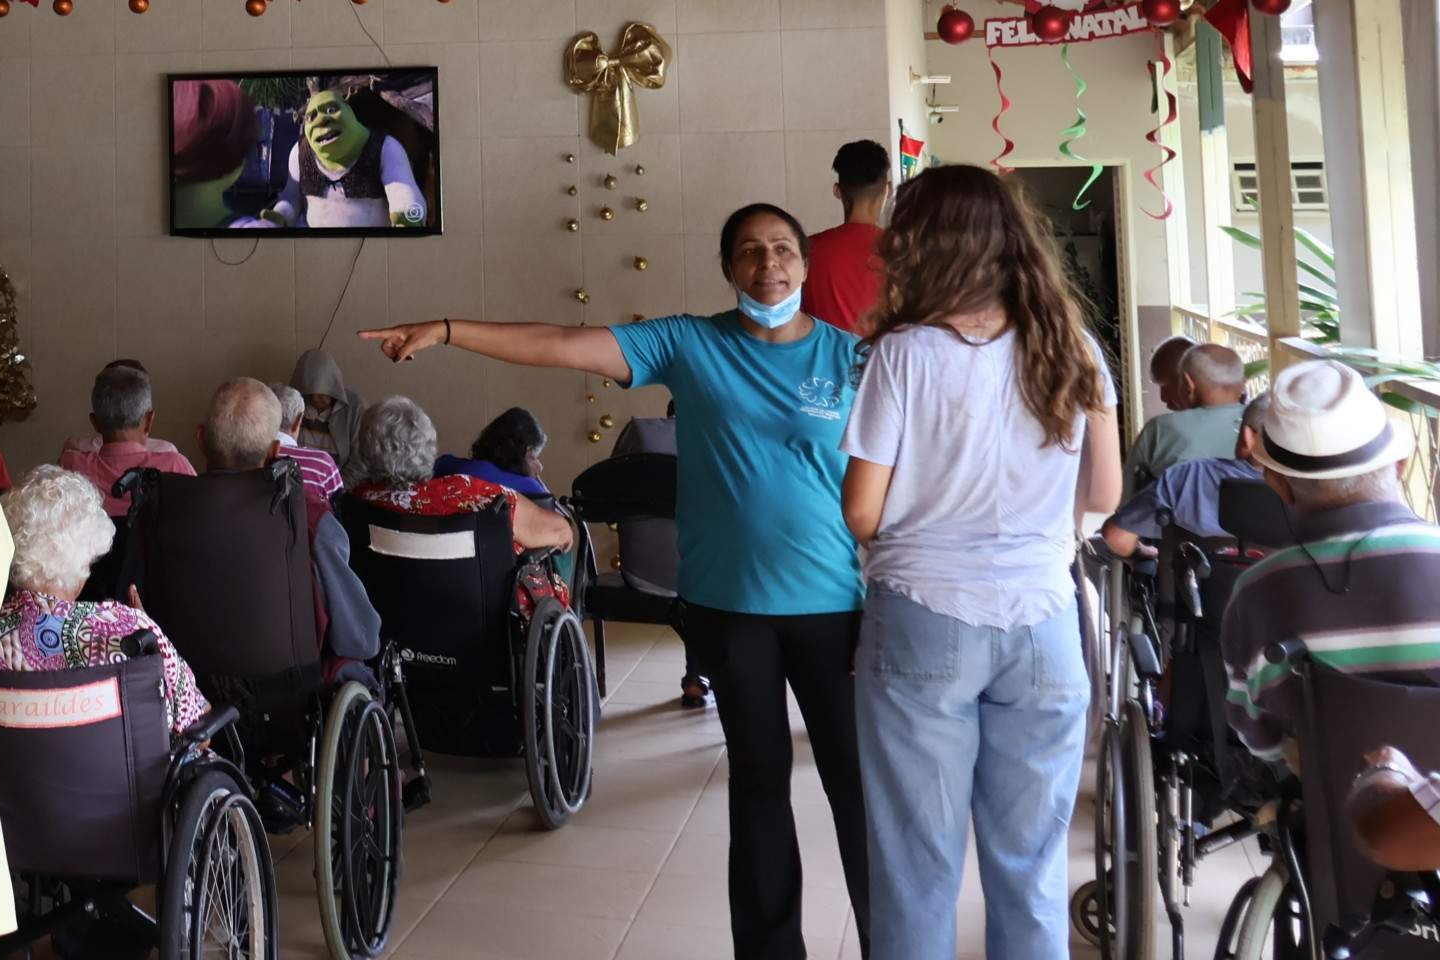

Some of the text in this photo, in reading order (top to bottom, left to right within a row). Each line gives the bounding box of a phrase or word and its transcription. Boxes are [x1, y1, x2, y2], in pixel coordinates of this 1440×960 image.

[986, 5, 1148, 45] FEL NATAL
[416, 651, 457, 665] freedom
